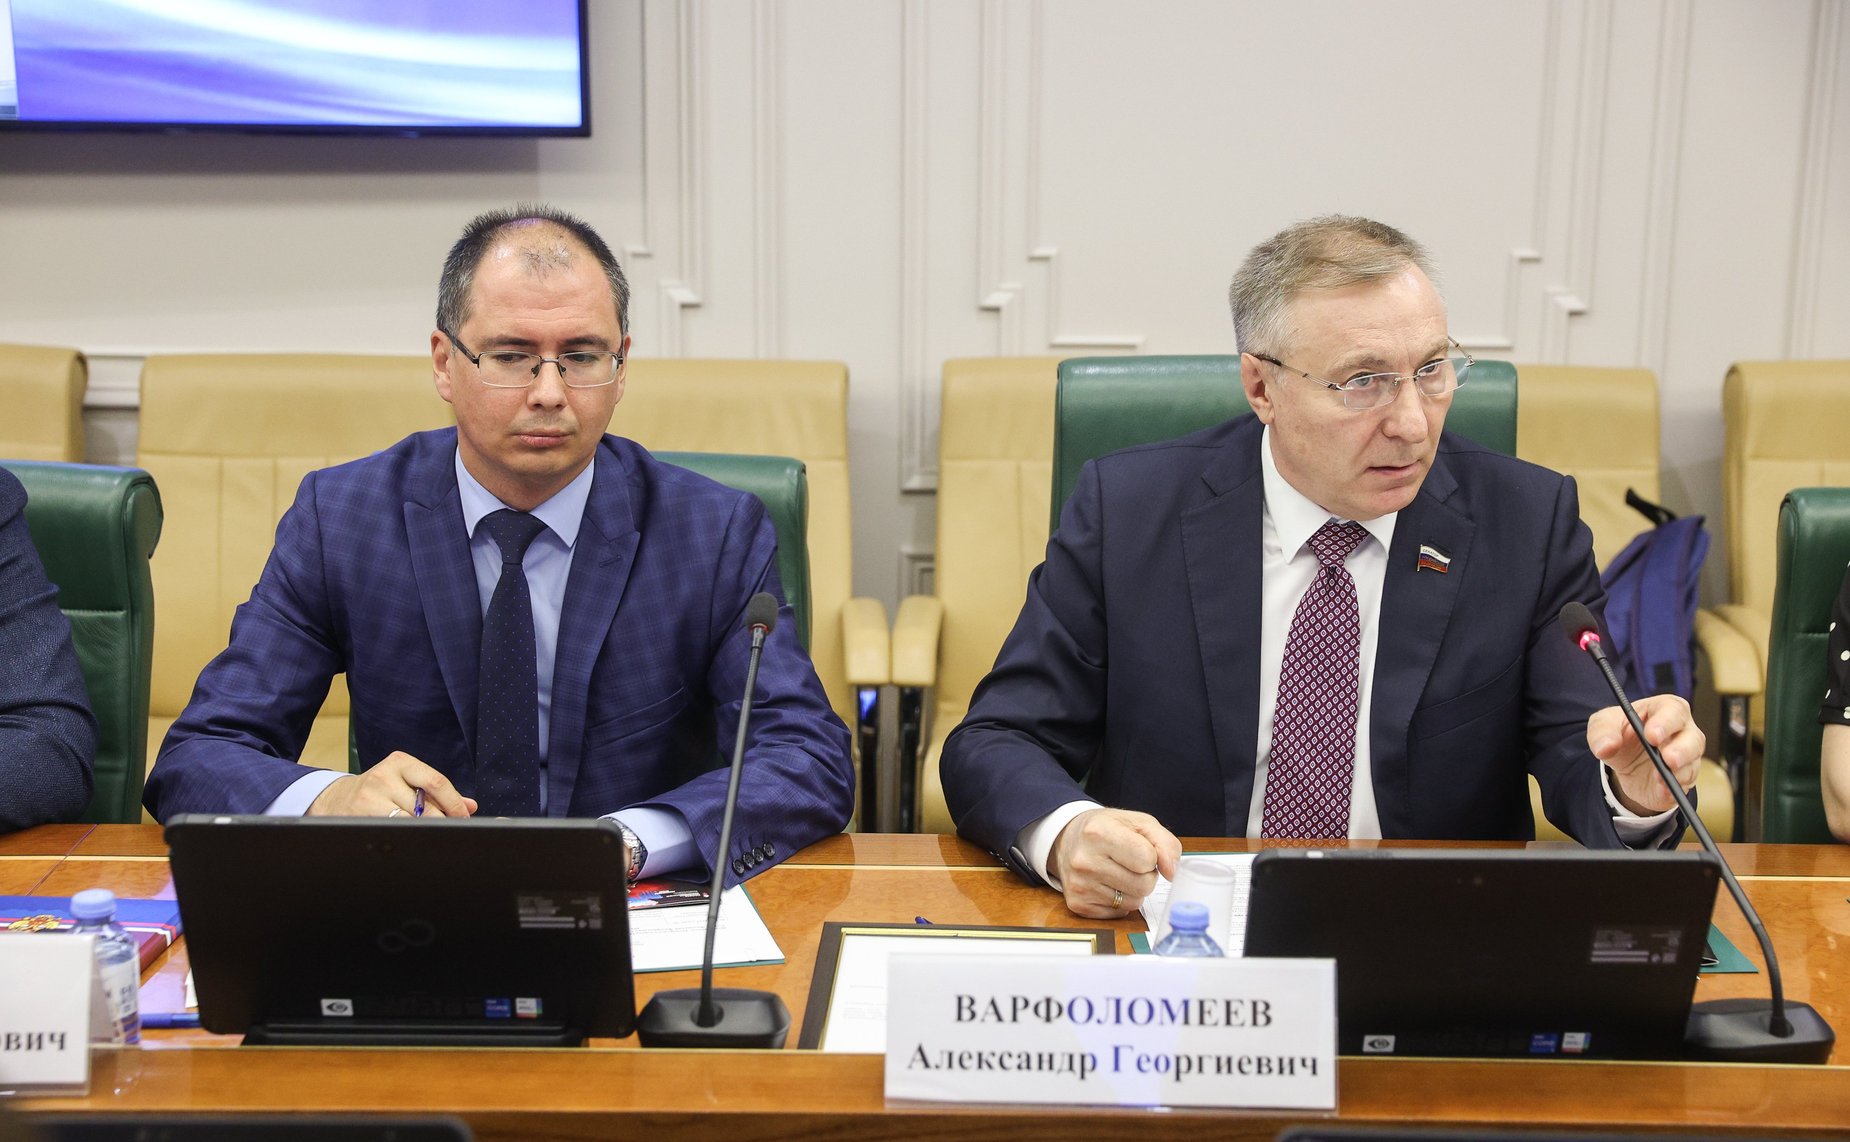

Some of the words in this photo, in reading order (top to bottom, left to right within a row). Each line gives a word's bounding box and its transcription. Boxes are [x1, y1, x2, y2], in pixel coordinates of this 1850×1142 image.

[954, 994, 1273, 1027] ВАРФОЛОМЕЕВ
[0, 1031, 67, 1051] вич
[908, 1043, 1098, 1079] Александр
[1112, 1044, 1319, 1082] Георгиевич
